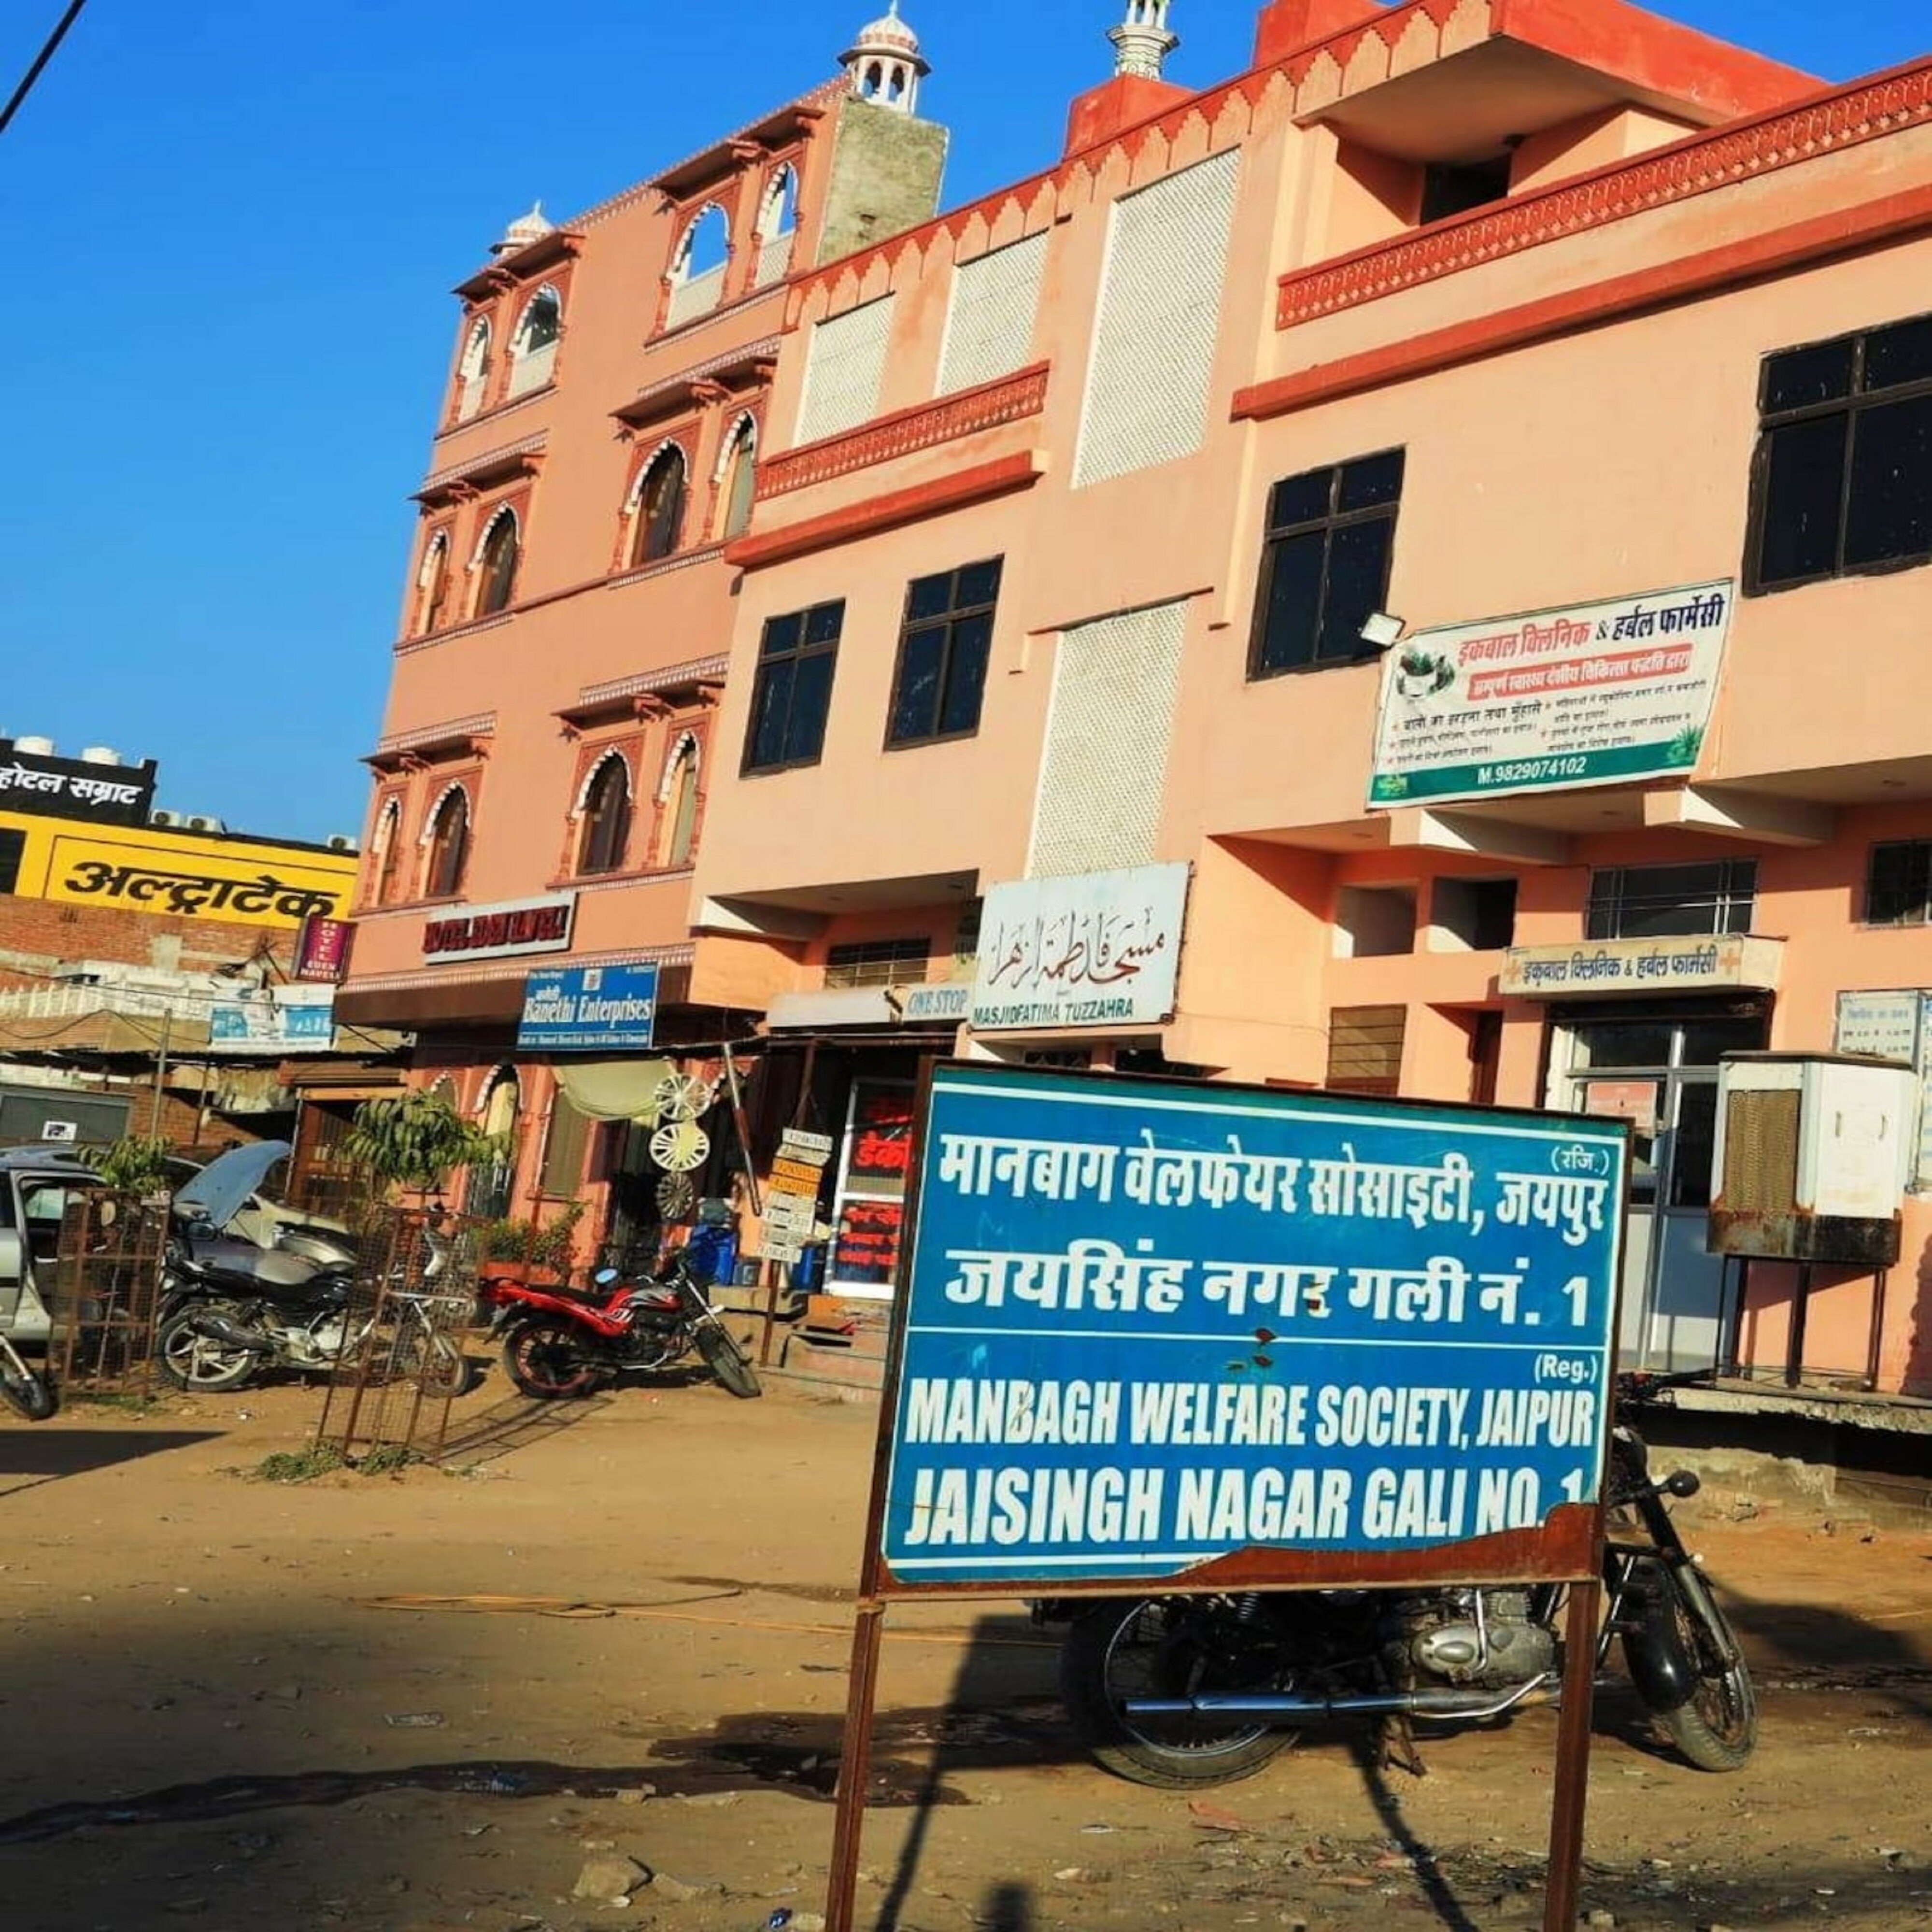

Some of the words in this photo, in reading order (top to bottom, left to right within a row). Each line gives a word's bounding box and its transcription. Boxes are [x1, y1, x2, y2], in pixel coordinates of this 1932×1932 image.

[1596, 620, 1609, 640] &
[1612, 605, 1657, 640] हर्बल
[1660, 593, 1725, 633] फार्मेसी
[0, 762, 67, 793] होटल
[69, 777, 143, 805] सम्राट
[1477, 756, 1586, 784] M.9829074102
[64, 862, 341, 919] अल्ट्राटेक
[577, 992, 652, 1029] Enterprises
[1065, 998, 1134, 1022] TUZZAHRA
[939, 1134, 1120, 1203] मानबाग
[1124, 1128, 1302, 1213] वेलफेयर
[1308, 1142, 1484, 1236] सोसाइटी,
[1496, 1171, 1608, 1246] जयपुर
[945, 1238, 1193, 1314] जयसिंह
[1202, 1261, 1338, 1319] नगर
[1348, 1256, 1472, 1322] गली
[1478, 1257, 1540, 1325] नं.
[1562, 1276, 1589, 1326] 1
[1534, 1354, 1598, 1384] (Reg.)
[904, 1378, 1122, 1444] MANBAGH
[1130, 1382, 1309, 1446] WELFARE
[1315, 1385, 1470, 1450] SOCIETY,
[1476, 1390, 1594, 1447] JAIPUR
[904, 1467, 1164, 1545] JAISINGH
[1174, 1467, 1352, 1541] NAGAR
[1362, 1467, 1467, 1539] GALI
